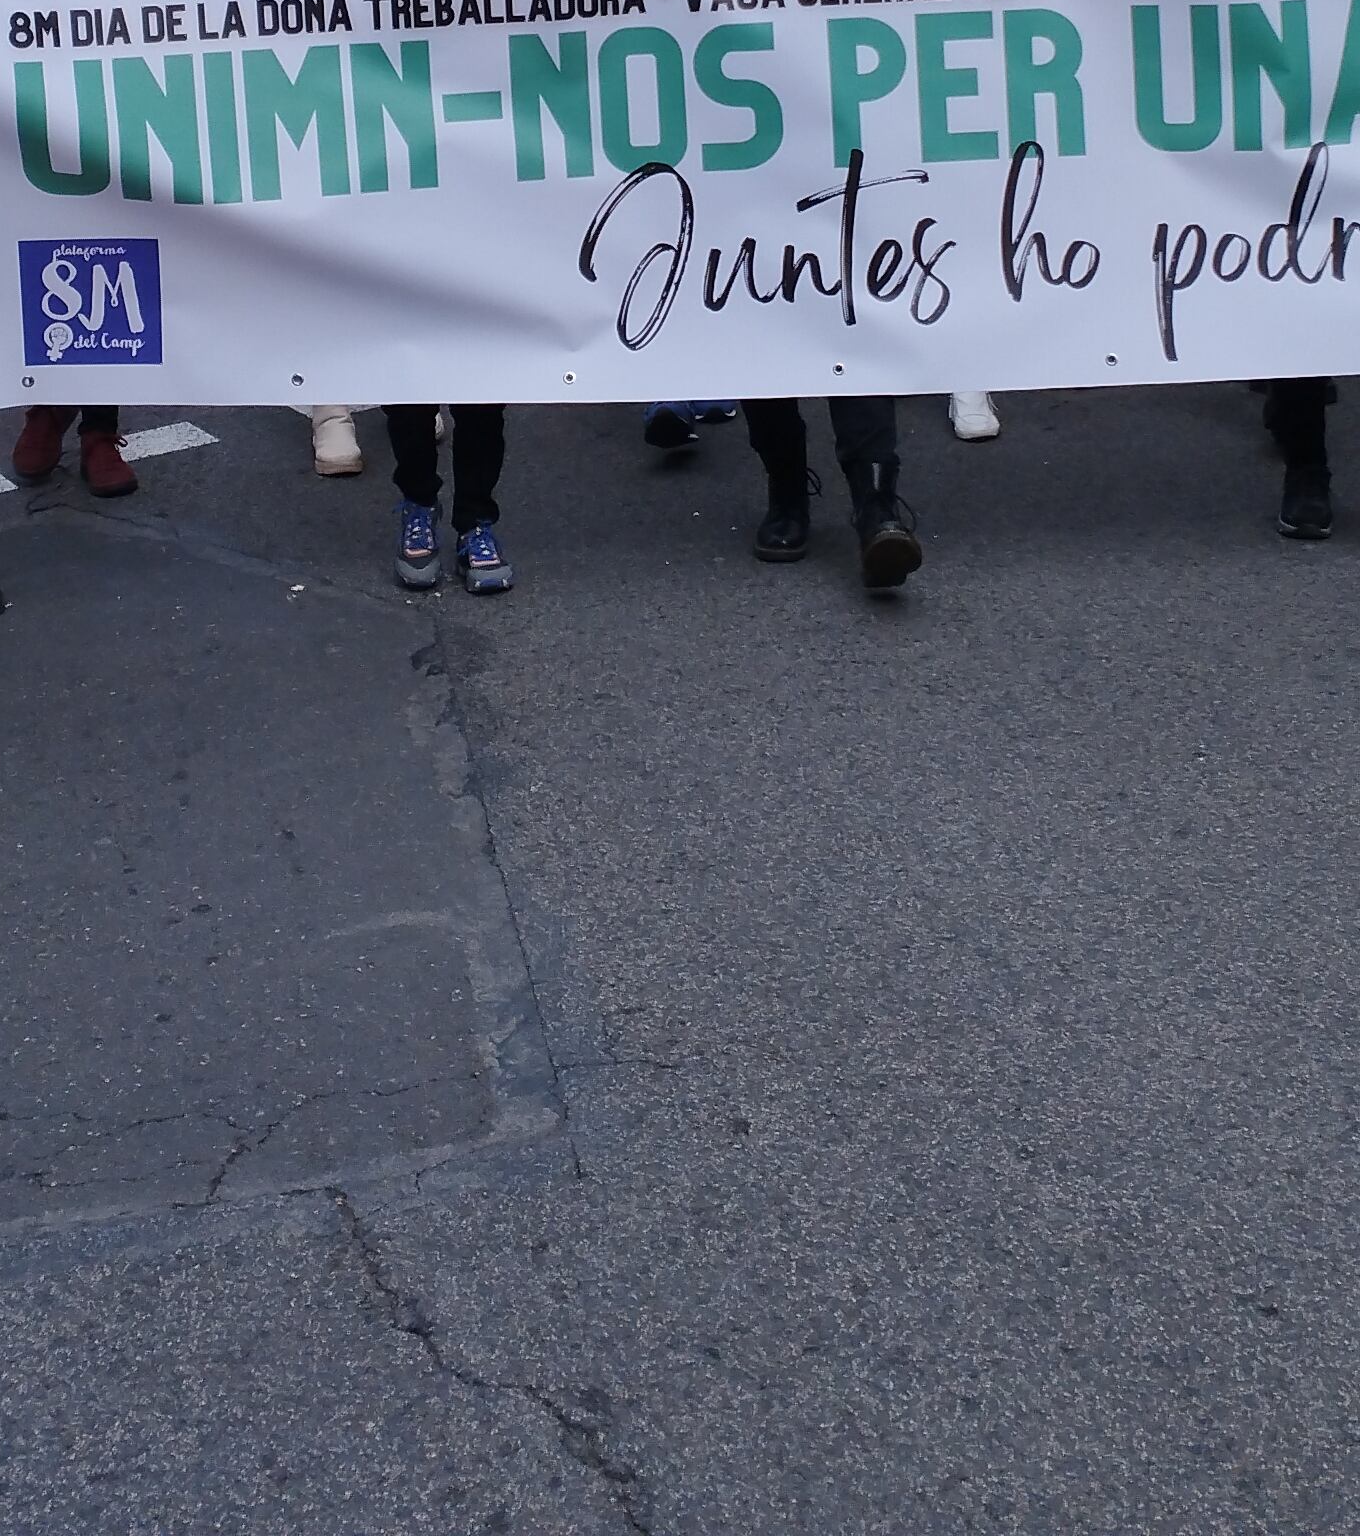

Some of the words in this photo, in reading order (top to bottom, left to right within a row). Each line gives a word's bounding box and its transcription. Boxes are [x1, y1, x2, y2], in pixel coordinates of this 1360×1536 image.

[9, 9, 61, 49] 8M
[70, 7, 132, 47] DIA
[141, 3, 187, 43] DE
[196, 0, 247, 40] LA
[13, 20, 786, 206] UNIMN-NOS
[827, 8, 1087, 169] PER
[52, 244, 127, 263] plataforma
[578, 148, 957, 351] Juntes
[998, 140, 1100, 302] ho
[41, 259, 145, 334] 8M
[73, 332, 99, 349] del
[101, 332, 145, 357] Camp
